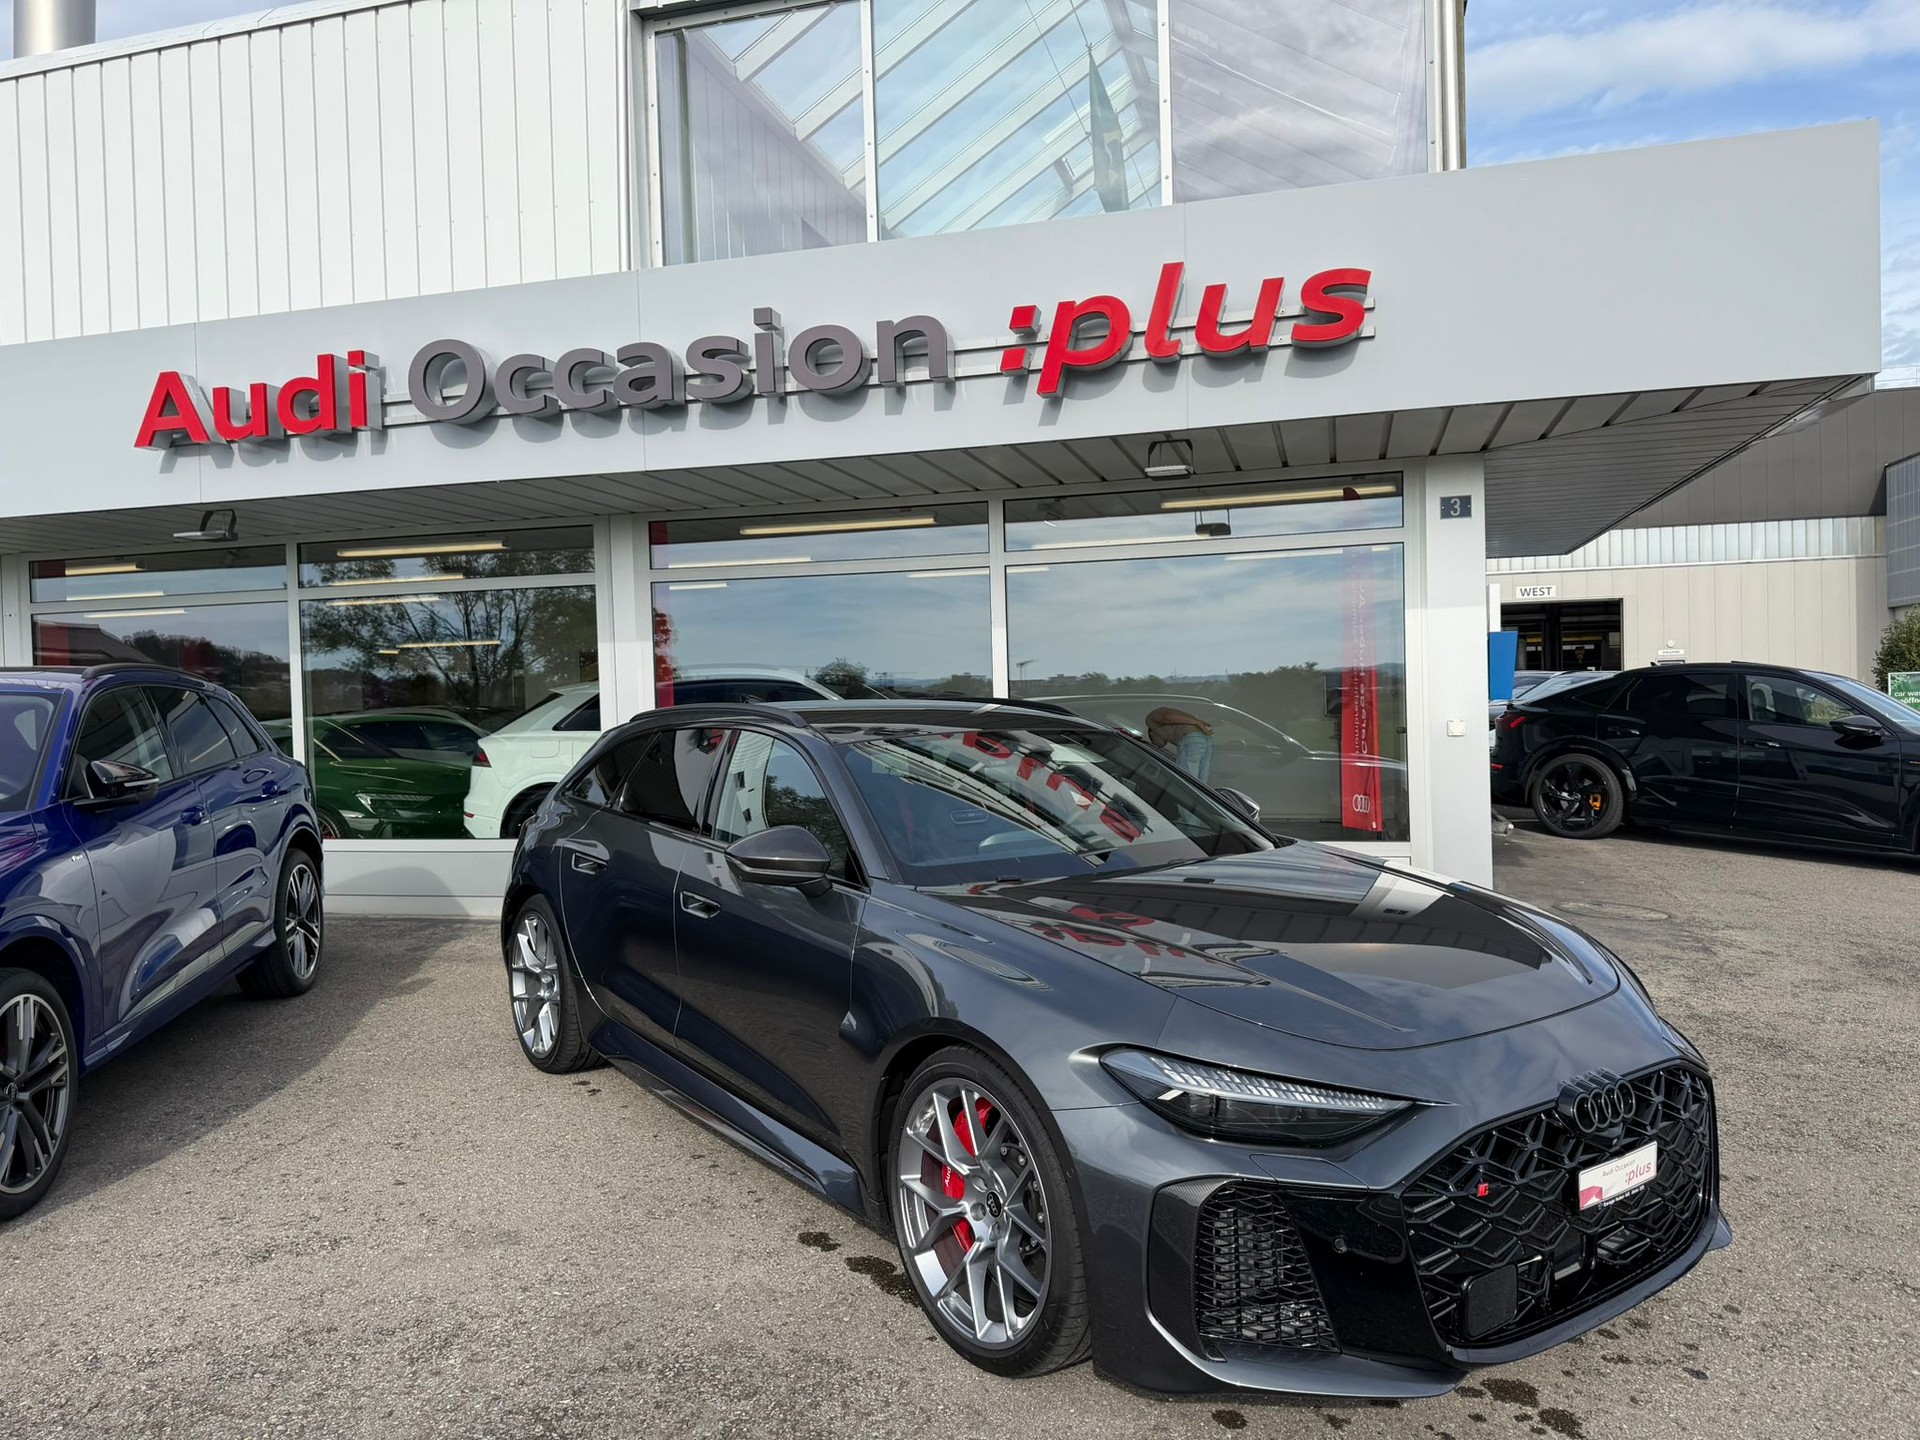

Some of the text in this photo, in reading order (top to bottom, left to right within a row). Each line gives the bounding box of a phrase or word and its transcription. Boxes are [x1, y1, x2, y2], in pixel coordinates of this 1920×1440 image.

[134, 349, 376, 450] Audi
[408, 307, 952, 425] Occasion
[1450, 498, 1461, 516] 3
[1520, 587, 1552, 597] WEST
